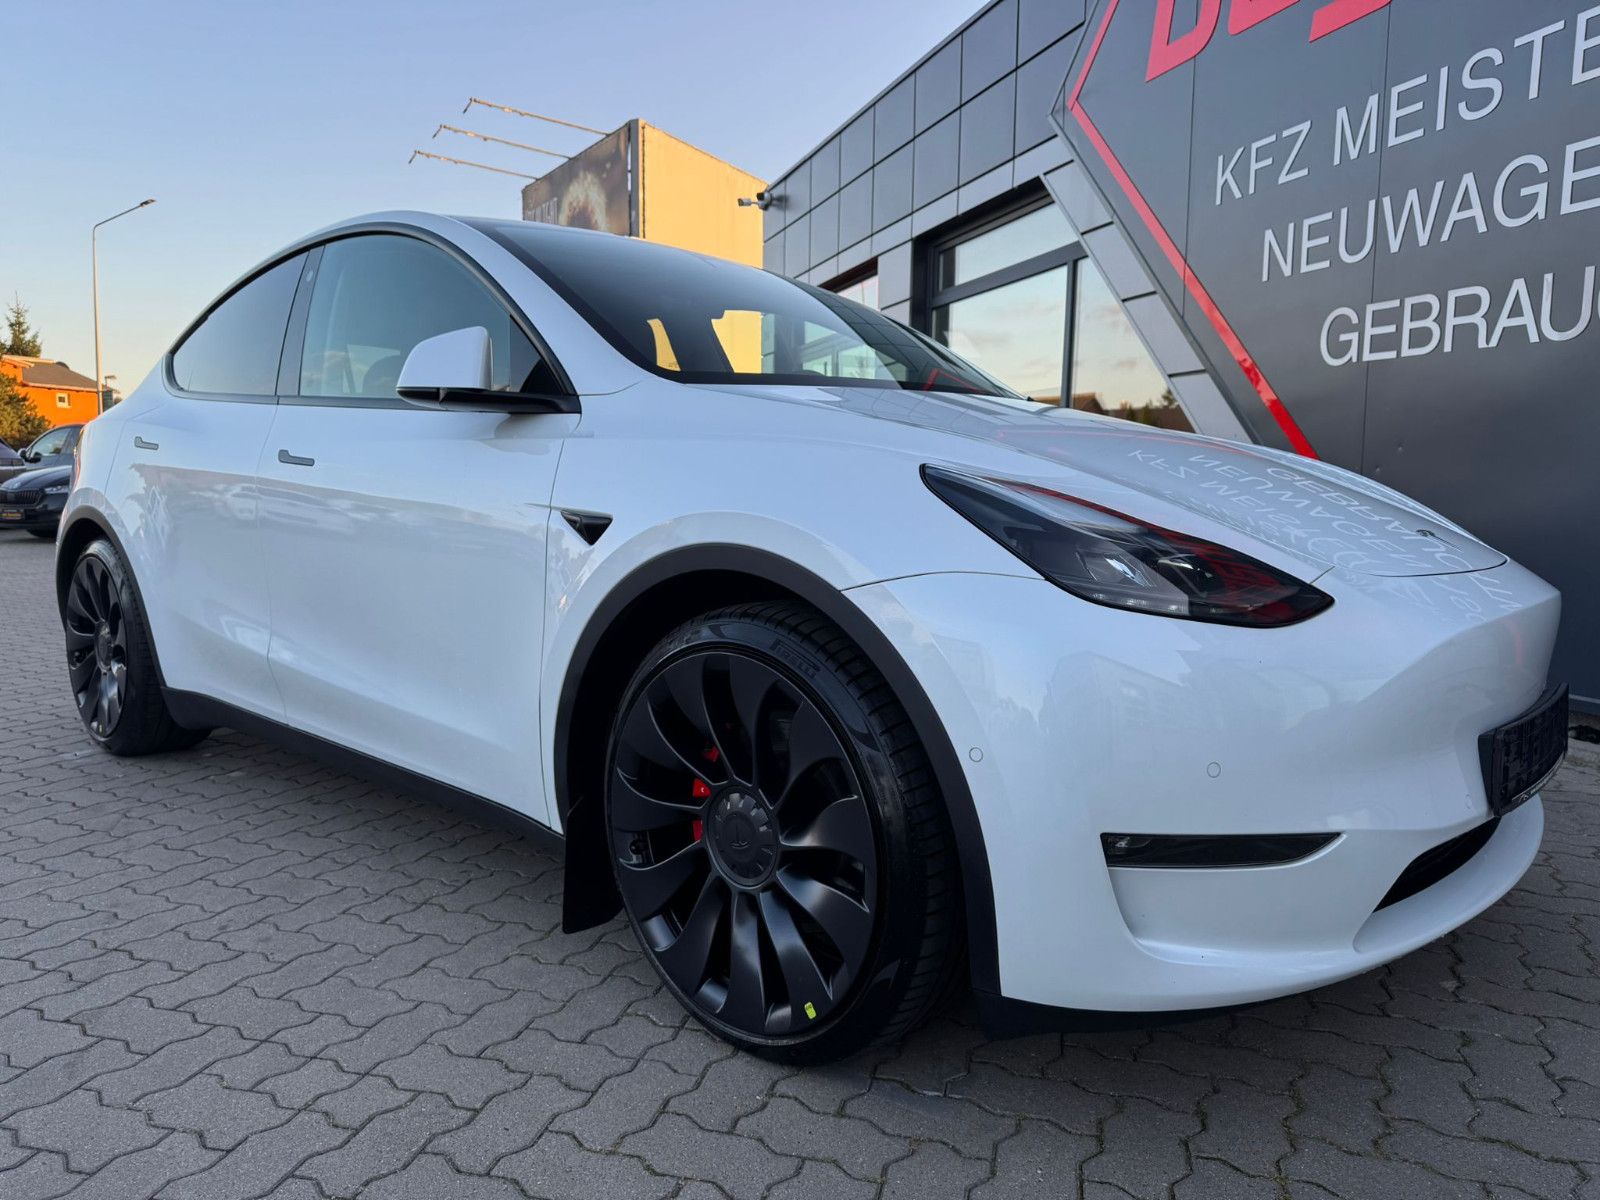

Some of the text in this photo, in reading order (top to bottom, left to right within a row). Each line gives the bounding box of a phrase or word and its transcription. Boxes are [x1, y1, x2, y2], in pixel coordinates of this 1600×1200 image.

[1215, 120, 1311, 205] KFZ
[1333, 5, 1600, 166] MEISTE
[1261, 135, 1600, 282] NEUWAGE
[1320, 265, 1600, 367] GEBRAU
